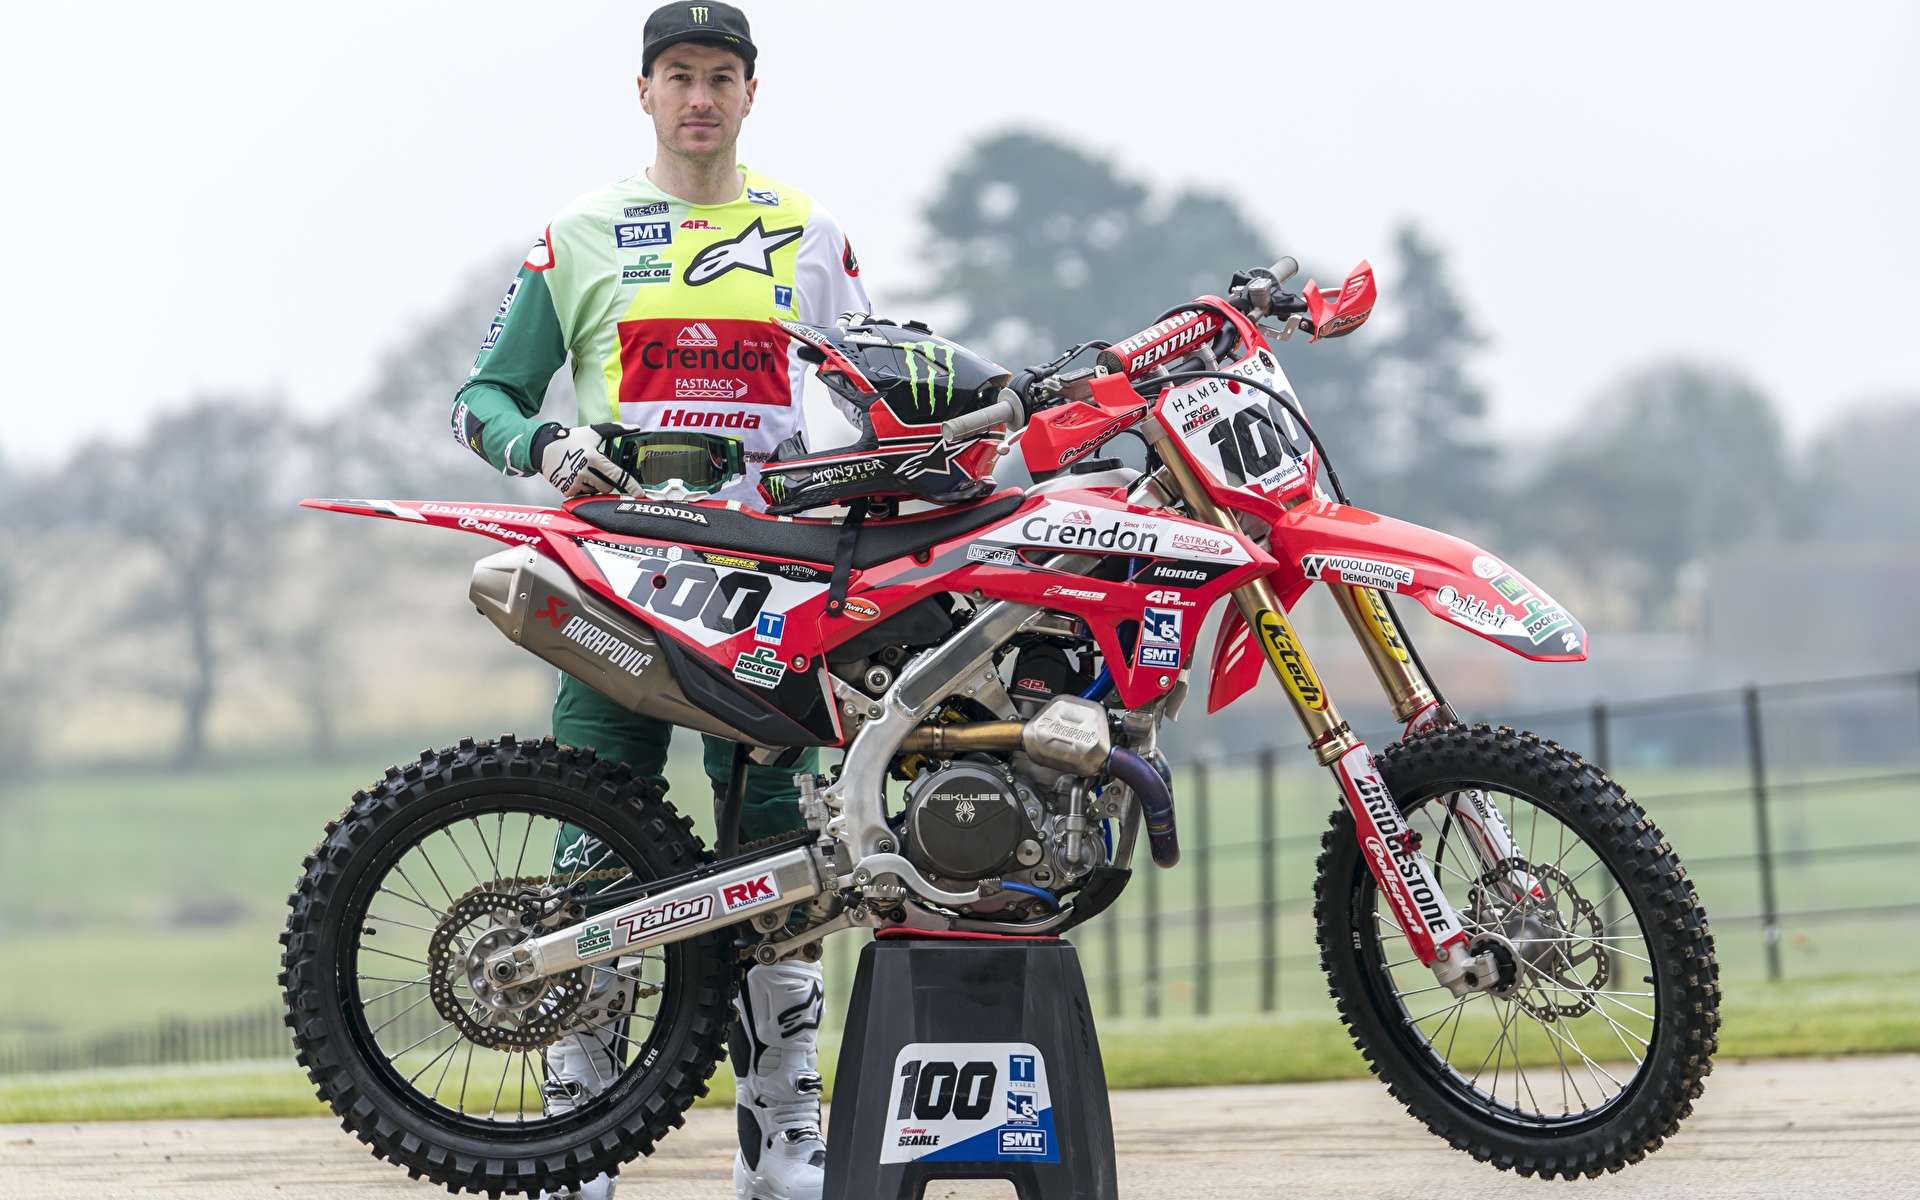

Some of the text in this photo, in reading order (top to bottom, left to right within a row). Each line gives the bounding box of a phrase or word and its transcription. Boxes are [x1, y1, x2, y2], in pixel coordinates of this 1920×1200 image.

[625, 203, 669, 218] Muc-Off
[620, 224, 666, 242] SMT
[623, 269, 671, 279] ROCK OIL
[1120, 309, 1205, 355] RENTHA
[743, 339, 774, 349] Since 1967
[1130, 316, 1217, 374] RENTHAL
[641, 340, 776, 374] Crendon
[675, 378, 734, 390] FASTRACK
[1172, 360, 1262, 412] HAMBRDGE
[660, 409, 762, 430] Honda
[1059, 423, 1120, 464] Polisport
[1208, 390, 1311, 488] 100
[812, 459, 885, 482] MONSTER
[824, 471, 876, 487] ENERGY
[1261, 465, 1298, 486] Toughsheet
[418, 503, 555, 525] BRIDGESTONE
[633, 503, 708, 524] HONDA
[460, 516, 542, 545] Polisport
[1022, 517, 1158, 552] Crendon
[1173, 534, 1221, 549] FASTRACK
[969, 545, 1014, 564] Muc-Off
[791, 565, 818, 577] FACTORY
[1154, 566, 1208, 581] Honda
[1329, 558, 1411, 583] WOOLDRIDGE
[1342, 572, 1394, 590] DEMOLITION
[627, 560, 772, 634] 100
[1438, 586, 1514, 629] Oakleaf
[845, 601, 877, 615] Twin Air
[1450, 608, 1474, 622] Building
[1526, 610, 1565, 636] ROCK OIL
[1142, 647, 1177, 662] SMT
[1262, 624, 1321, 702] K-tech
[738, 660, 782, 678] ROCK OIL
[930, 793, 1001, 801] REKLUSE
[1354, 775, 1451, 934] BRIDGESTONE
[722, 875, 774, 907] RK
[1367, 839, 1425, 935] Polisport
[728, 892, 776, 911] TAKASAGO CHAIN
[616, 895, 712, 937] Talon
[577, 934, 611, 950] ROCK OIL
[897, 1060, 998, 1120] 100
[1009, 1081, 1036, 1089] TYSERS
[898, 1135, 941, 1147] SEARLE
[901, 1126, 927, 1136] Tommy
[1002, 1132, 1043, 1147] SMT
